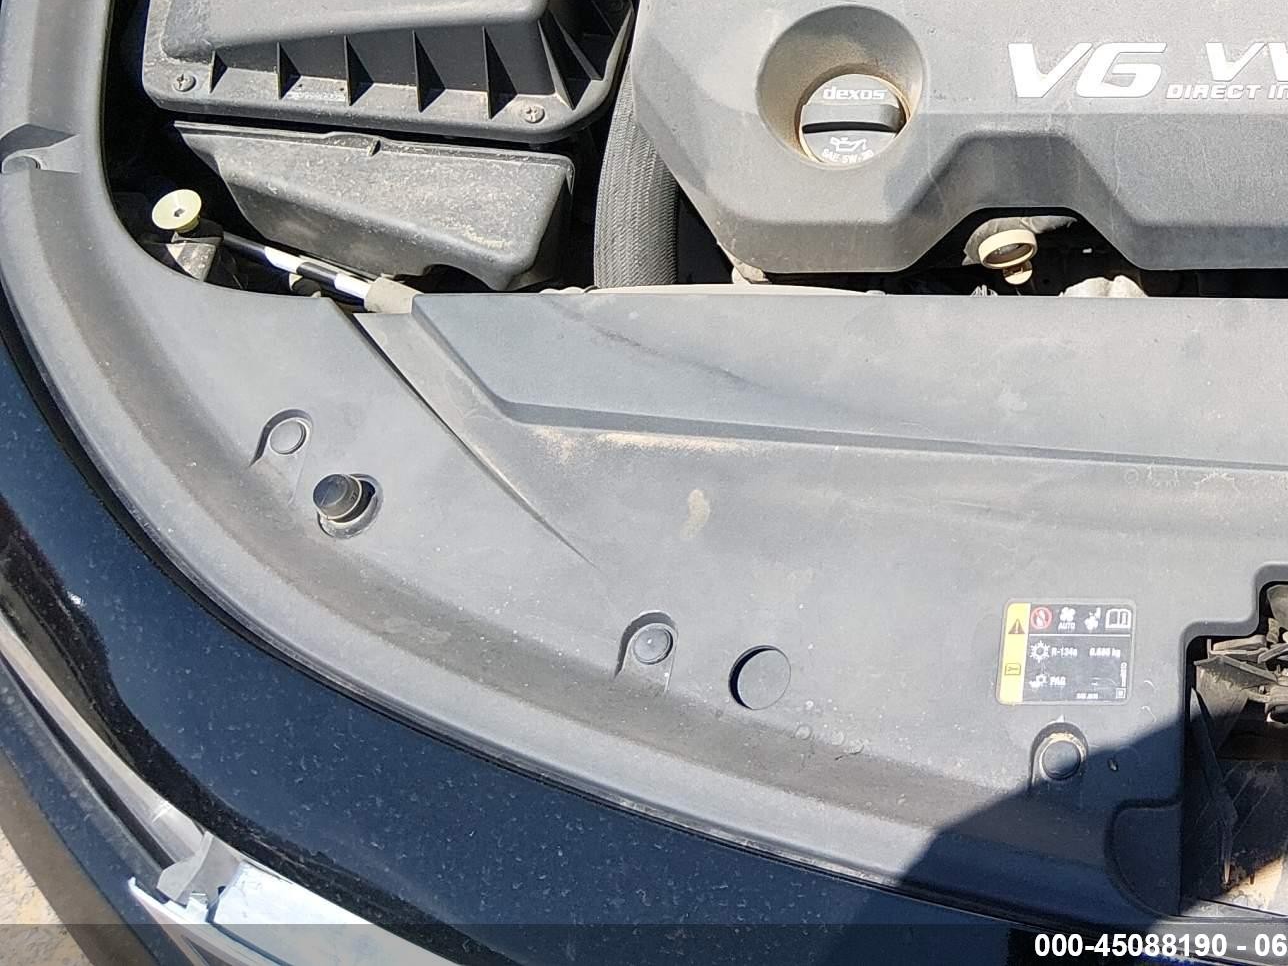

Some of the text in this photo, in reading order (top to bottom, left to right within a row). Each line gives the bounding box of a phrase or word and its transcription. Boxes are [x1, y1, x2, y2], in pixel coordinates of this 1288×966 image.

[1008, 42, 1168, 98] V6
[823, 87, 887, 100] dexos
[1166, 83, 1263, 100] DIRECT
[1058, 622, 1076, 630] AUTO
